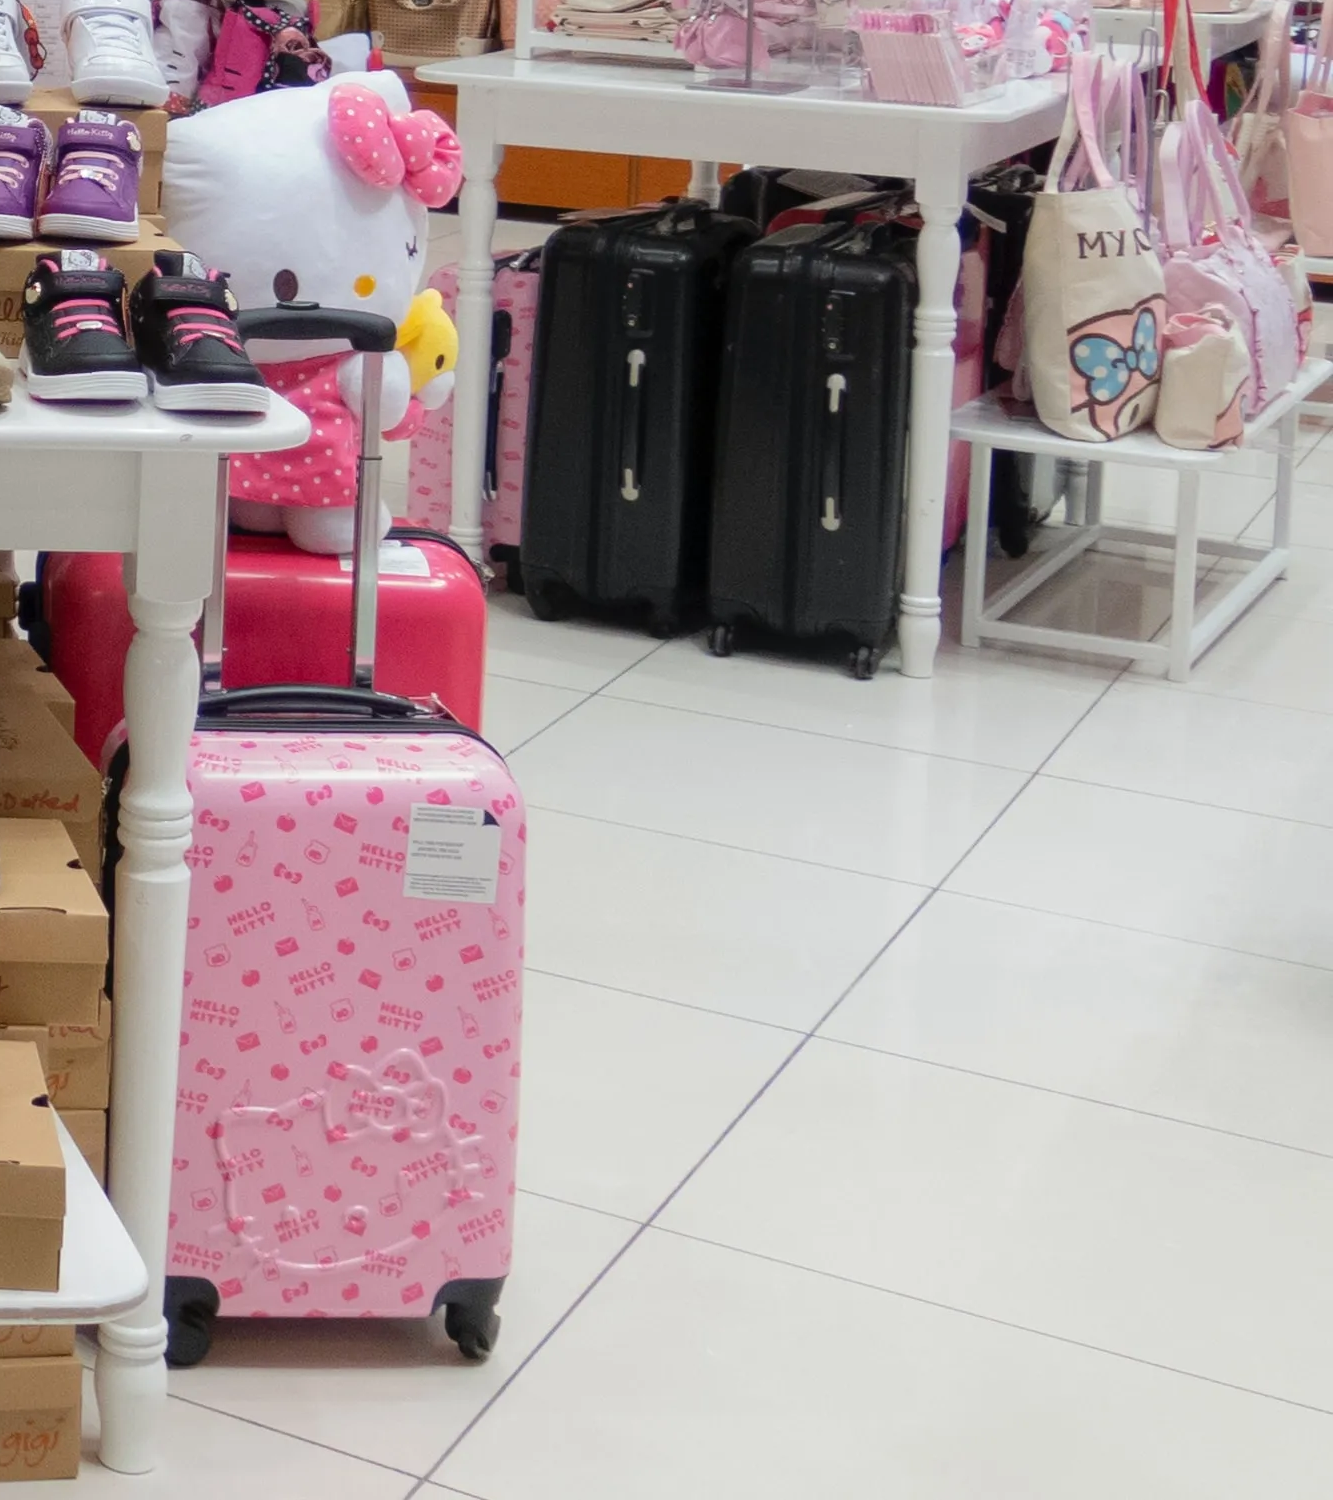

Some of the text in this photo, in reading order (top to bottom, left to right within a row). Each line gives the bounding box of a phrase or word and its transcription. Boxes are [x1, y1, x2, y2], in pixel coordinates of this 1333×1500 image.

[67, 127, 114, 140] Hello Kitty
[375, 756, 422, 773] HELLO
[358, 854, 404, 874] KITTY
[361, 842, 406, 863] HELLO
[227, 901, 272, 926] HELLO
[233, 911, 276, 937] KITTY
[414, 908, 459, 931] HELLO
[419, 918, 463, 942] KITTY
[288, 961, 332, 985] HELLO
[293, 971, 336, 996] KITTY
[472, 969, 516, 992] HELLO
[476, 979, 518, 1003] KITTY
[189, 1010, 239, 1028] KITTY
[191, 998, 240, 1017] HELLO
[379, 1001, 424, 1021] HELLO
[377, 1013, 423, 1032] KITTY
[351, 1089, 396, 1108] HELLO
[216, 1148, 262, 1172] HELLO
[221, 1158, 266, 1183] KITTY
[402, 1151, 446, 1176] HELLO
[407, 1162, 451, 1188] KITTY
[273, 1208, 317, 1232] HELLO
[278, 1219, 321, 1244] KITTY
[457, 1208, 503, 1233] HELLO
[462, 1218, 506, 1244] KITTY
[174, 1241, 224, 1261] HELLO
[364, 1249, 408, 1267] HELLO
[172, 1253, 222, 1273] KITTY
[361, 1260, 406, 1279] KITTY
